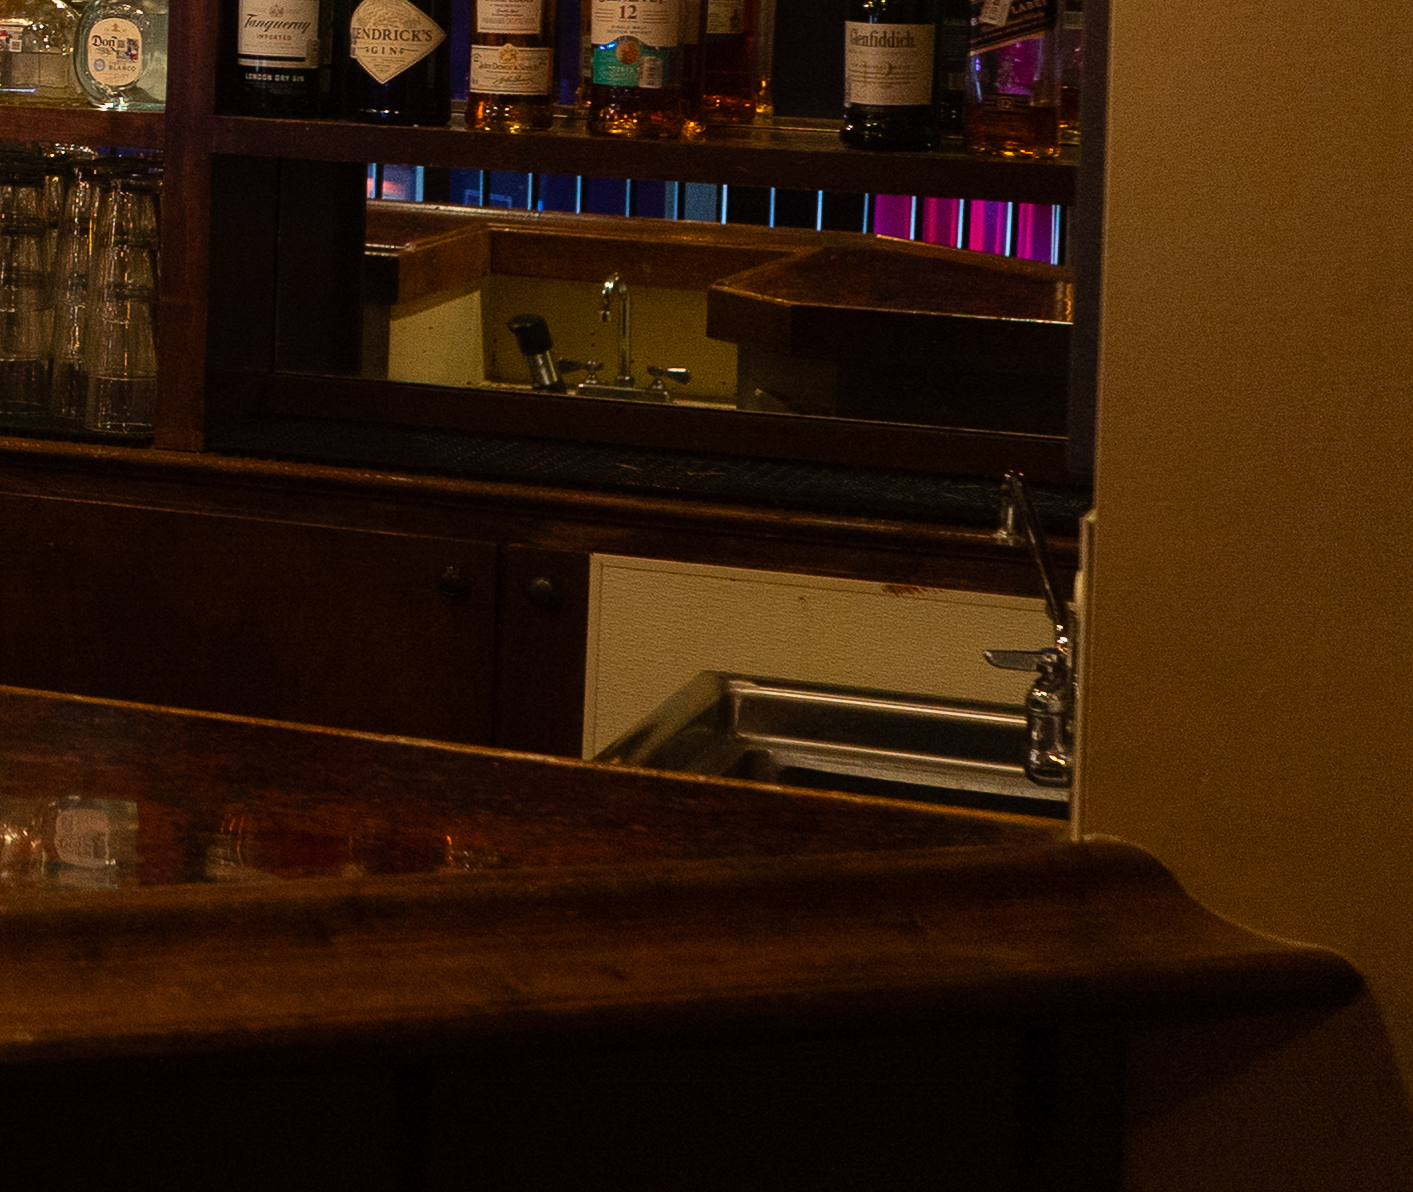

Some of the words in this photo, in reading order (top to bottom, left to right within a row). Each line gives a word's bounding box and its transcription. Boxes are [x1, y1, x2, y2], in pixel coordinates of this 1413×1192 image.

[619, 4, 638, 20] 12
[244, 13, 312, 34] Tanqueray
[92, 35, 118, 52] Don
[371, 46, 398, 55] GIN
